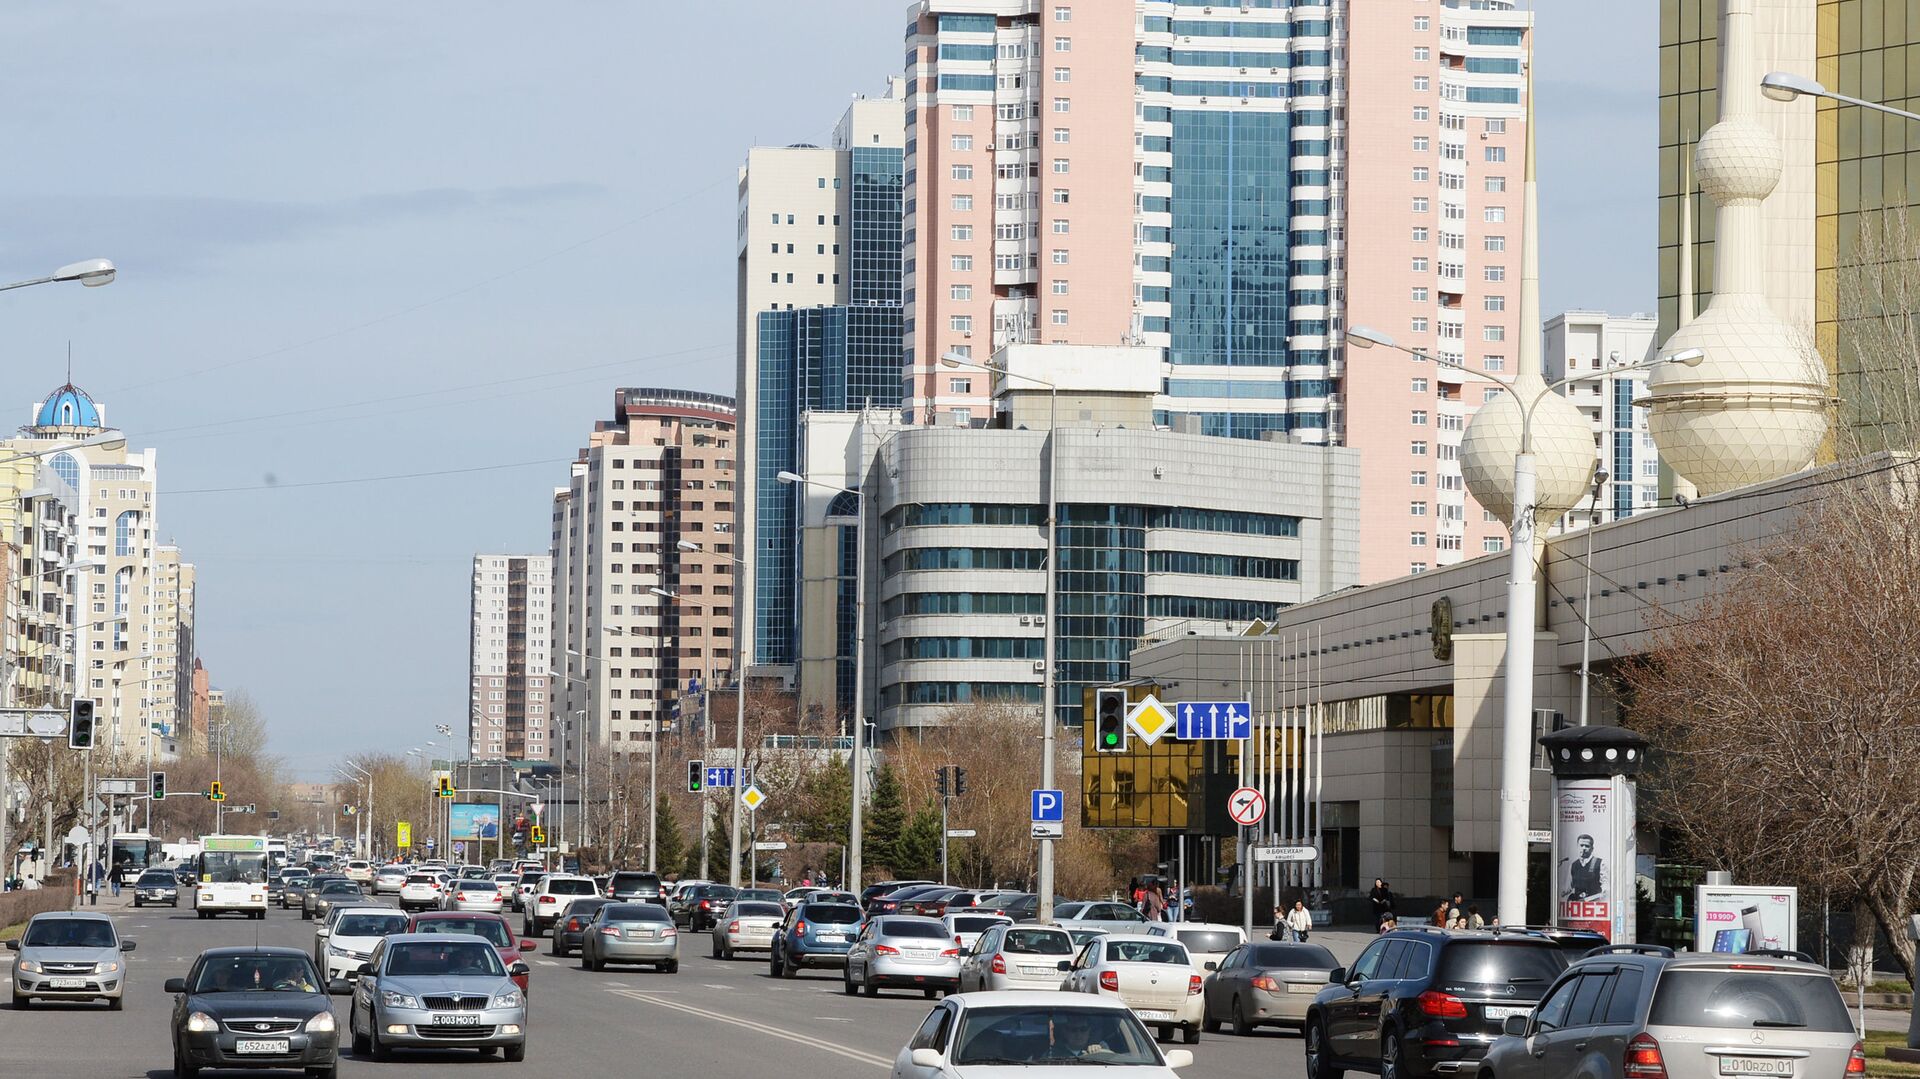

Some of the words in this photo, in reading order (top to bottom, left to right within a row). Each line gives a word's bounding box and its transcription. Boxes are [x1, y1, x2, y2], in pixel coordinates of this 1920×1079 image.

[1038, 793, 1056, 818] P
[1592, 794, 1606, 804] 25
[1731, 1059, 1774, 1072] 010RZD
[1777, 1061, 1792, 1073] 01
